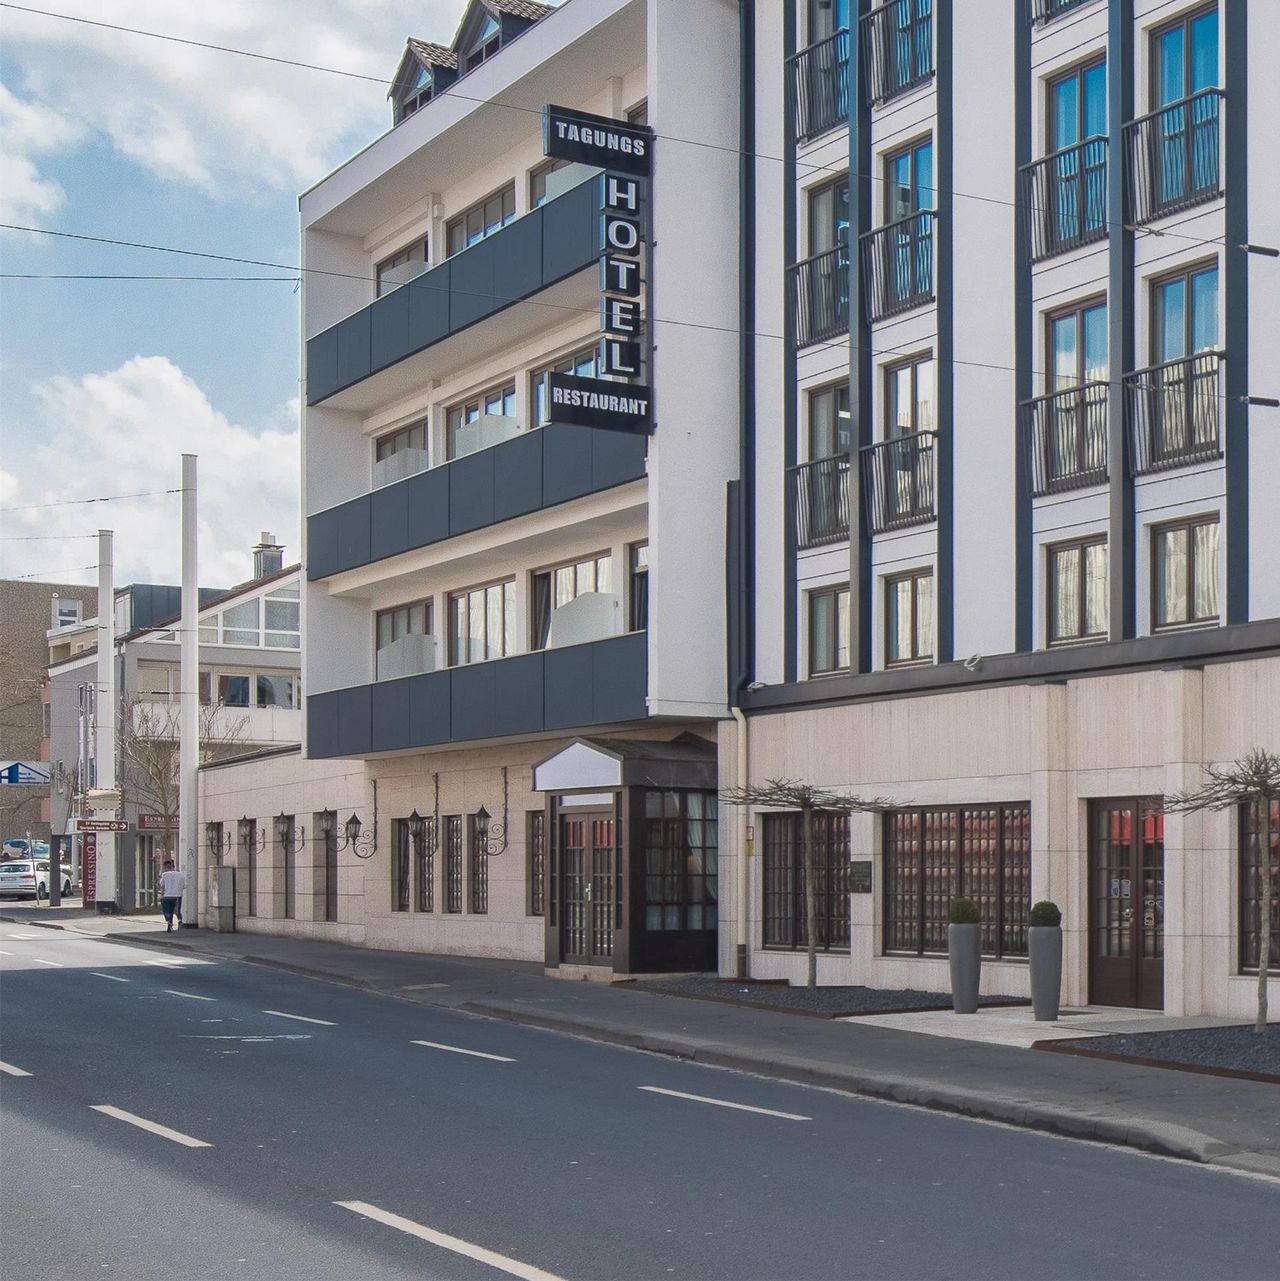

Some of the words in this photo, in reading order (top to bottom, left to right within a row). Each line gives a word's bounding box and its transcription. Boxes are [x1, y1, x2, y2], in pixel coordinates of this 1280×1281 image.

[555, 120, 646, 157] TAGUNGS
[608, 177, 637, 373] HOTEL
[552, 386, 648, 416] RESTAURANT
